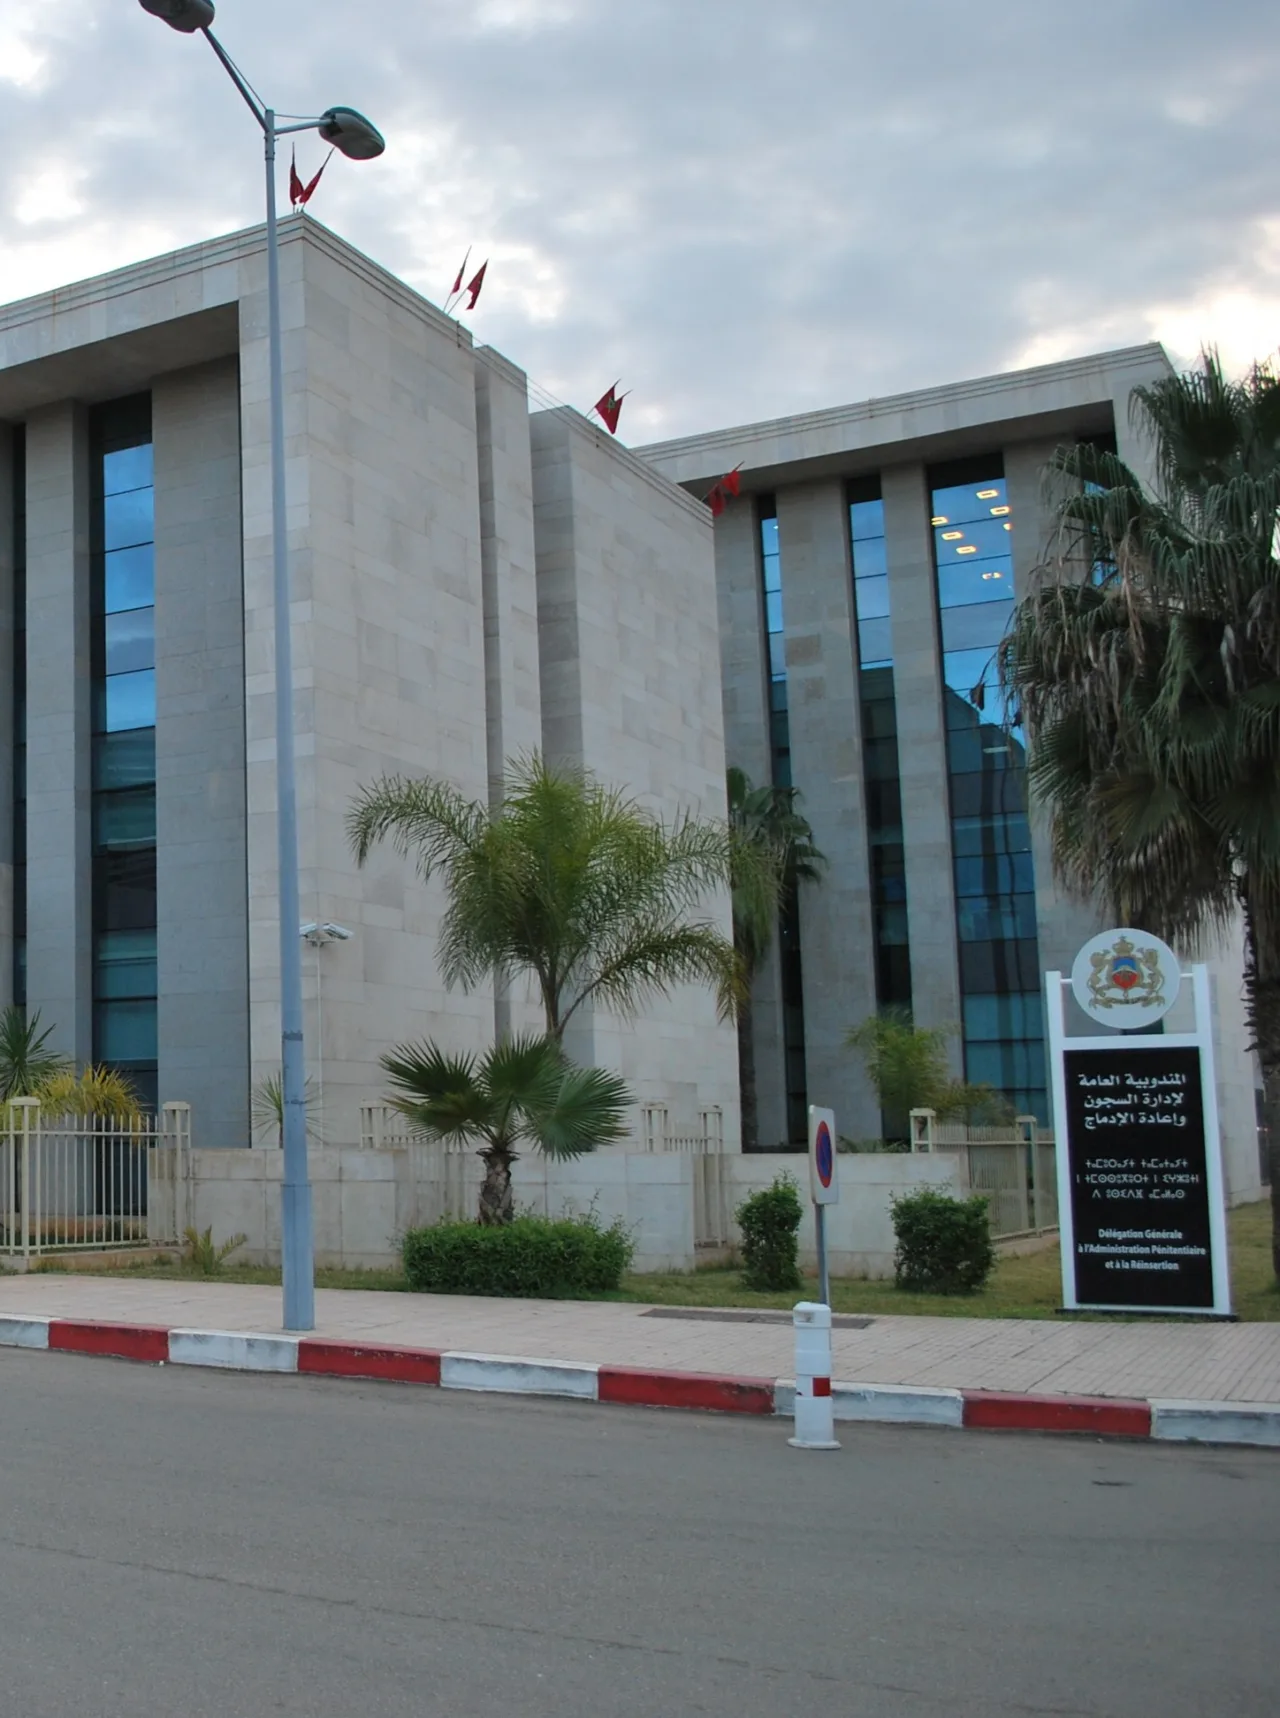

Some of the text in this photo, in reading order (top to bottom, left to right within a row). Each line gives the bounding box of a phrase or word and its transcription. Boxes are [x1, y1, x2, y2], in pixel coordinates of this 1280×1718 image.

[1078, 1073, 1186, 1089] المندوبية العامة
[1084, 1092, 1184, 1108] لإدارة السجون
[1084, 1112, 1134, 1130] الإدماج
[1098, 1228, 1183, 1240] Délégation Générale
[1078, 1244, 1206, 1255] à l'Administration Pénitentiaire
[1104, 1259, 1180, 1270] et à la Réinsertion
